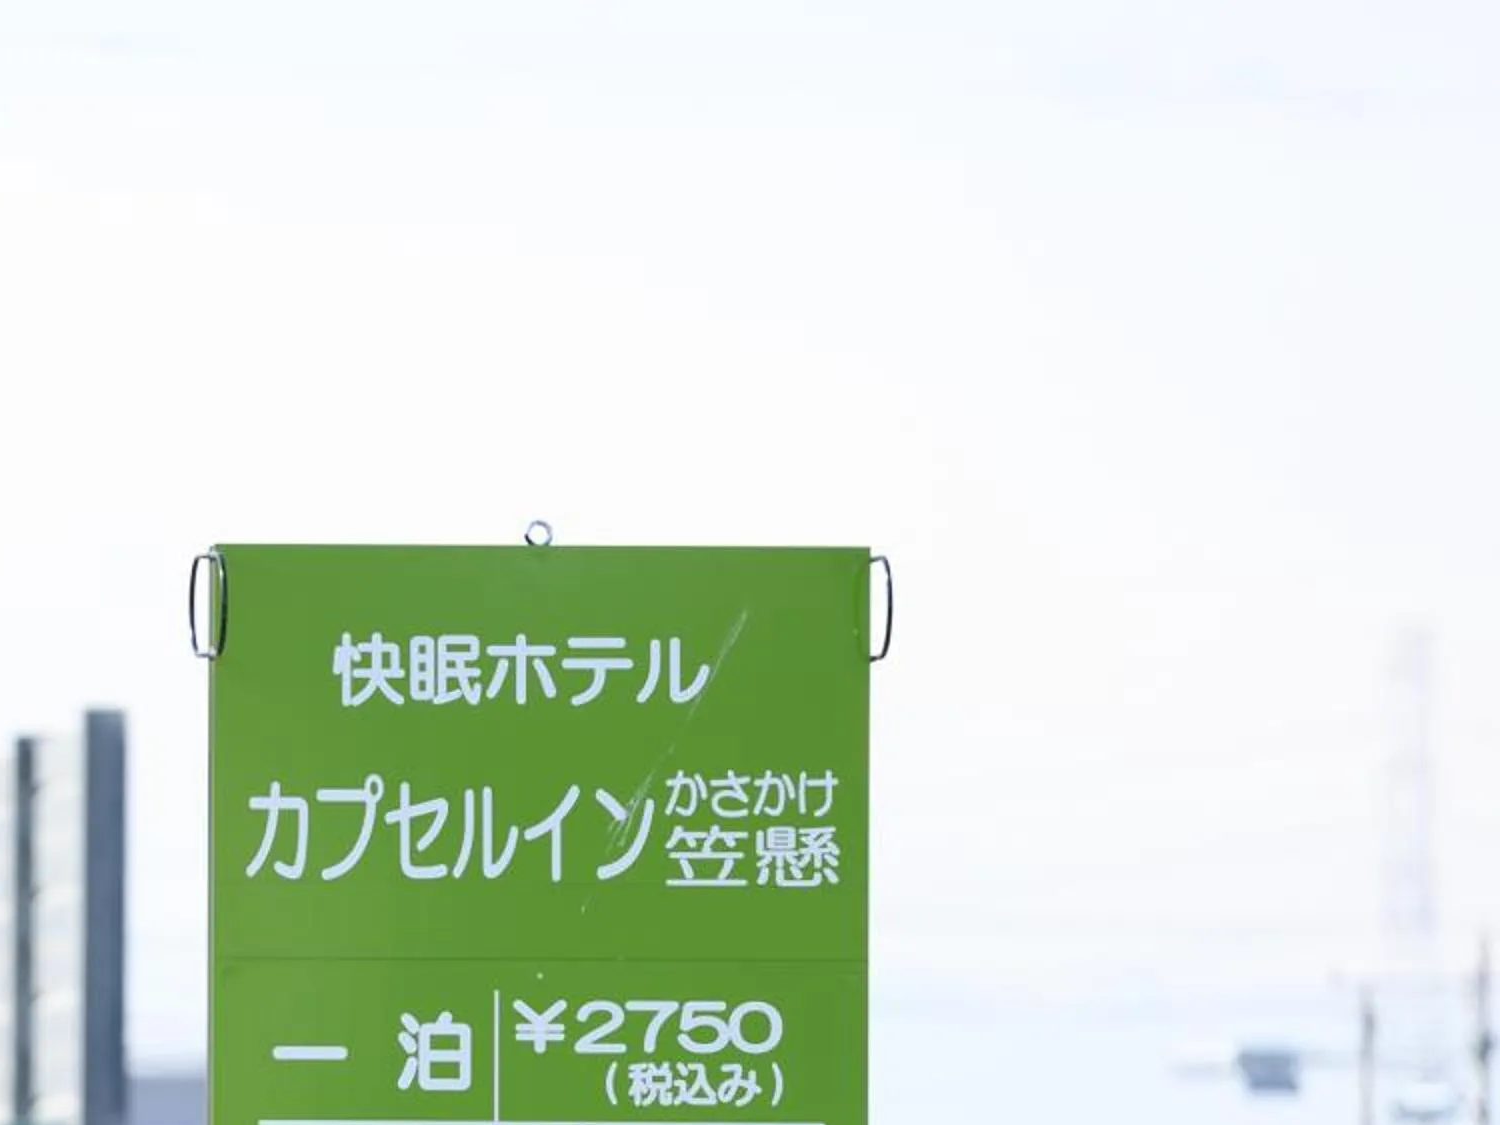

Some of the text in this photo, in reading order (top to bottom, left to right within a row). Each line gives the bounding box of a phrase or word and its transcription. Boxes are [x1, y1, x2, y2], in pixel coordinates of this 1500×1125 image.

[332, 632, 711, 707] 快眠ホテル
[665, 770, 841, 819] かさかけ
[513, 1000, 785, 1055] ¥2750
